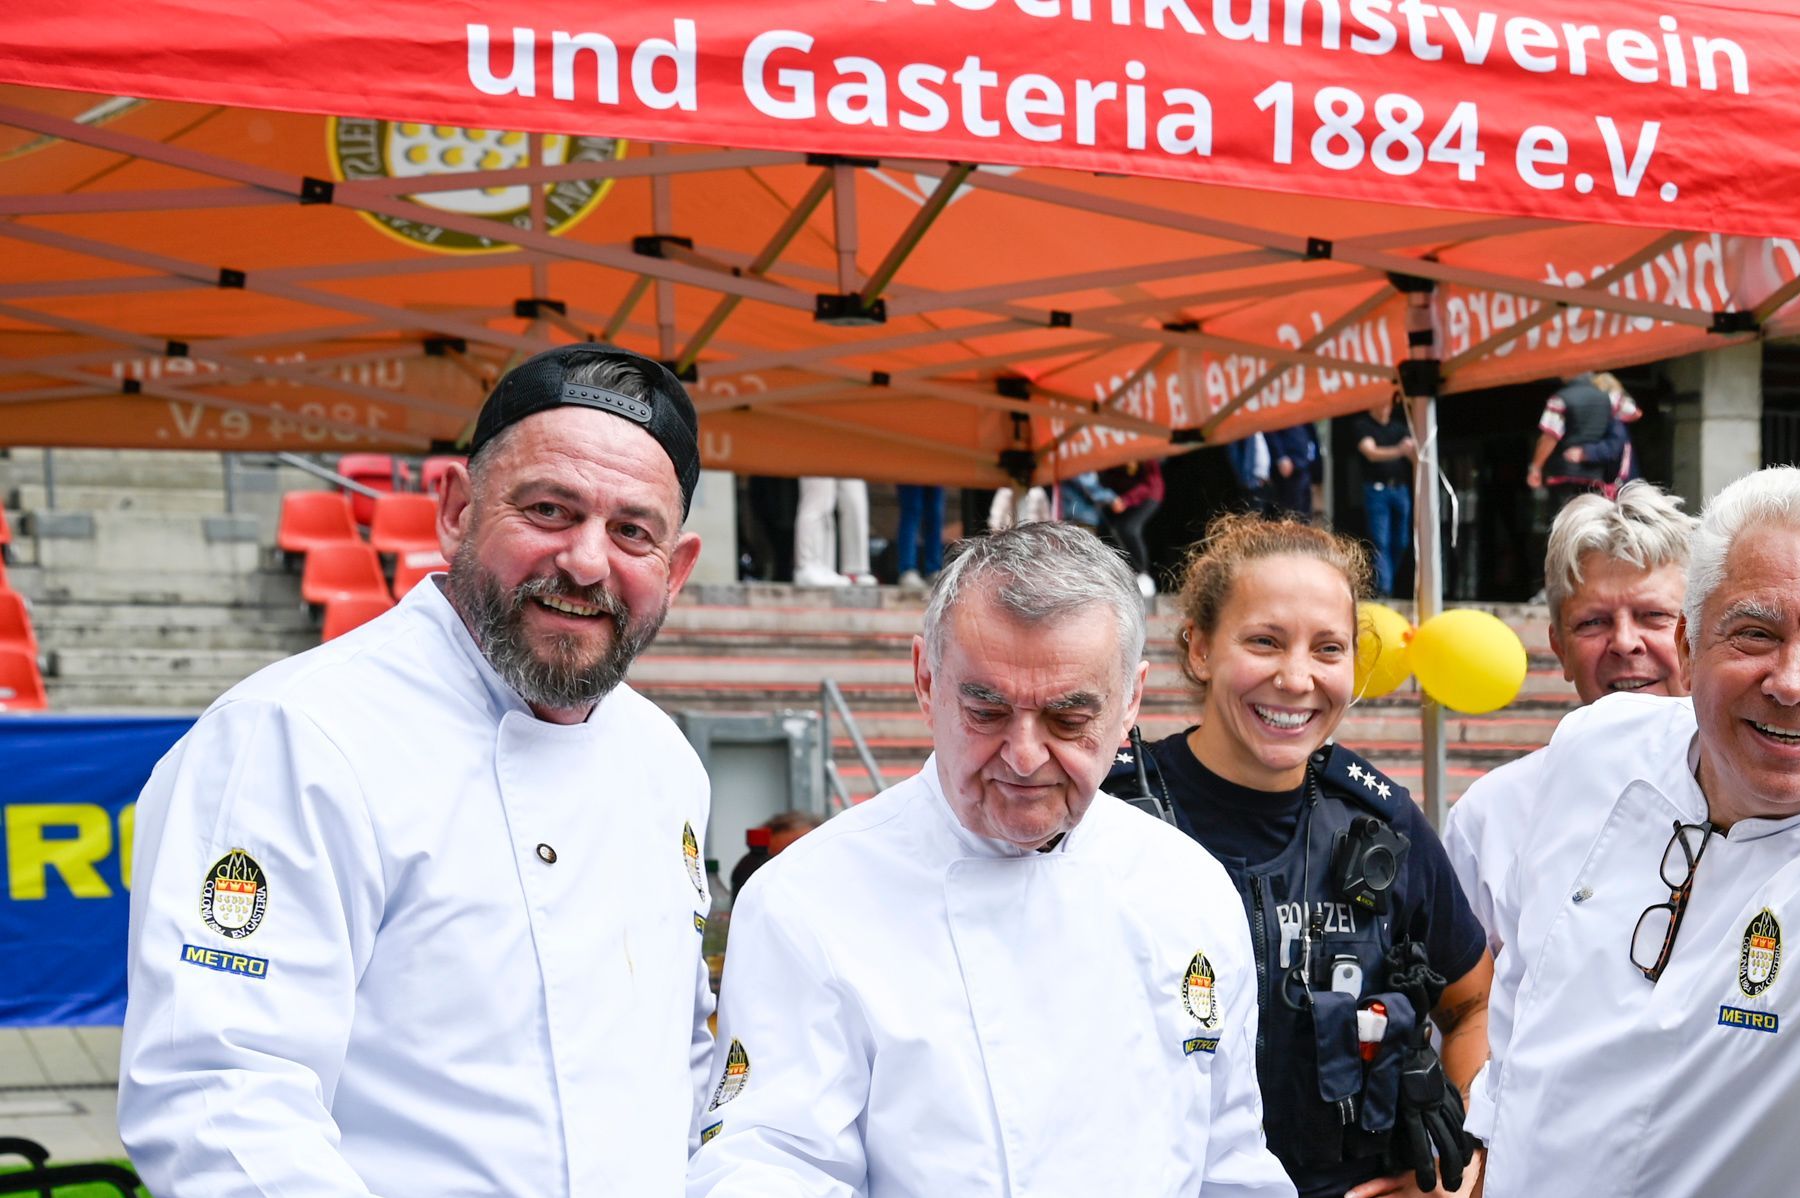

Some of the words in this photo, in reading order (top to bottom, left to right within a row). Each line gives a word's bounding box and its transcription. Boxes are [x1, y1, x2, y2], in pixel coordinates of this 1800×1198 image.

[466, 18, 698, 112] und
[742, 30, 1213, 157] Gasteria
[1253, 80, 1485, 182] 1884
[1515, 115, 1679, 203] e.V.
[185, 946, 266, 976] METRO
[1721, 1007, 1776, 1029] METRO
